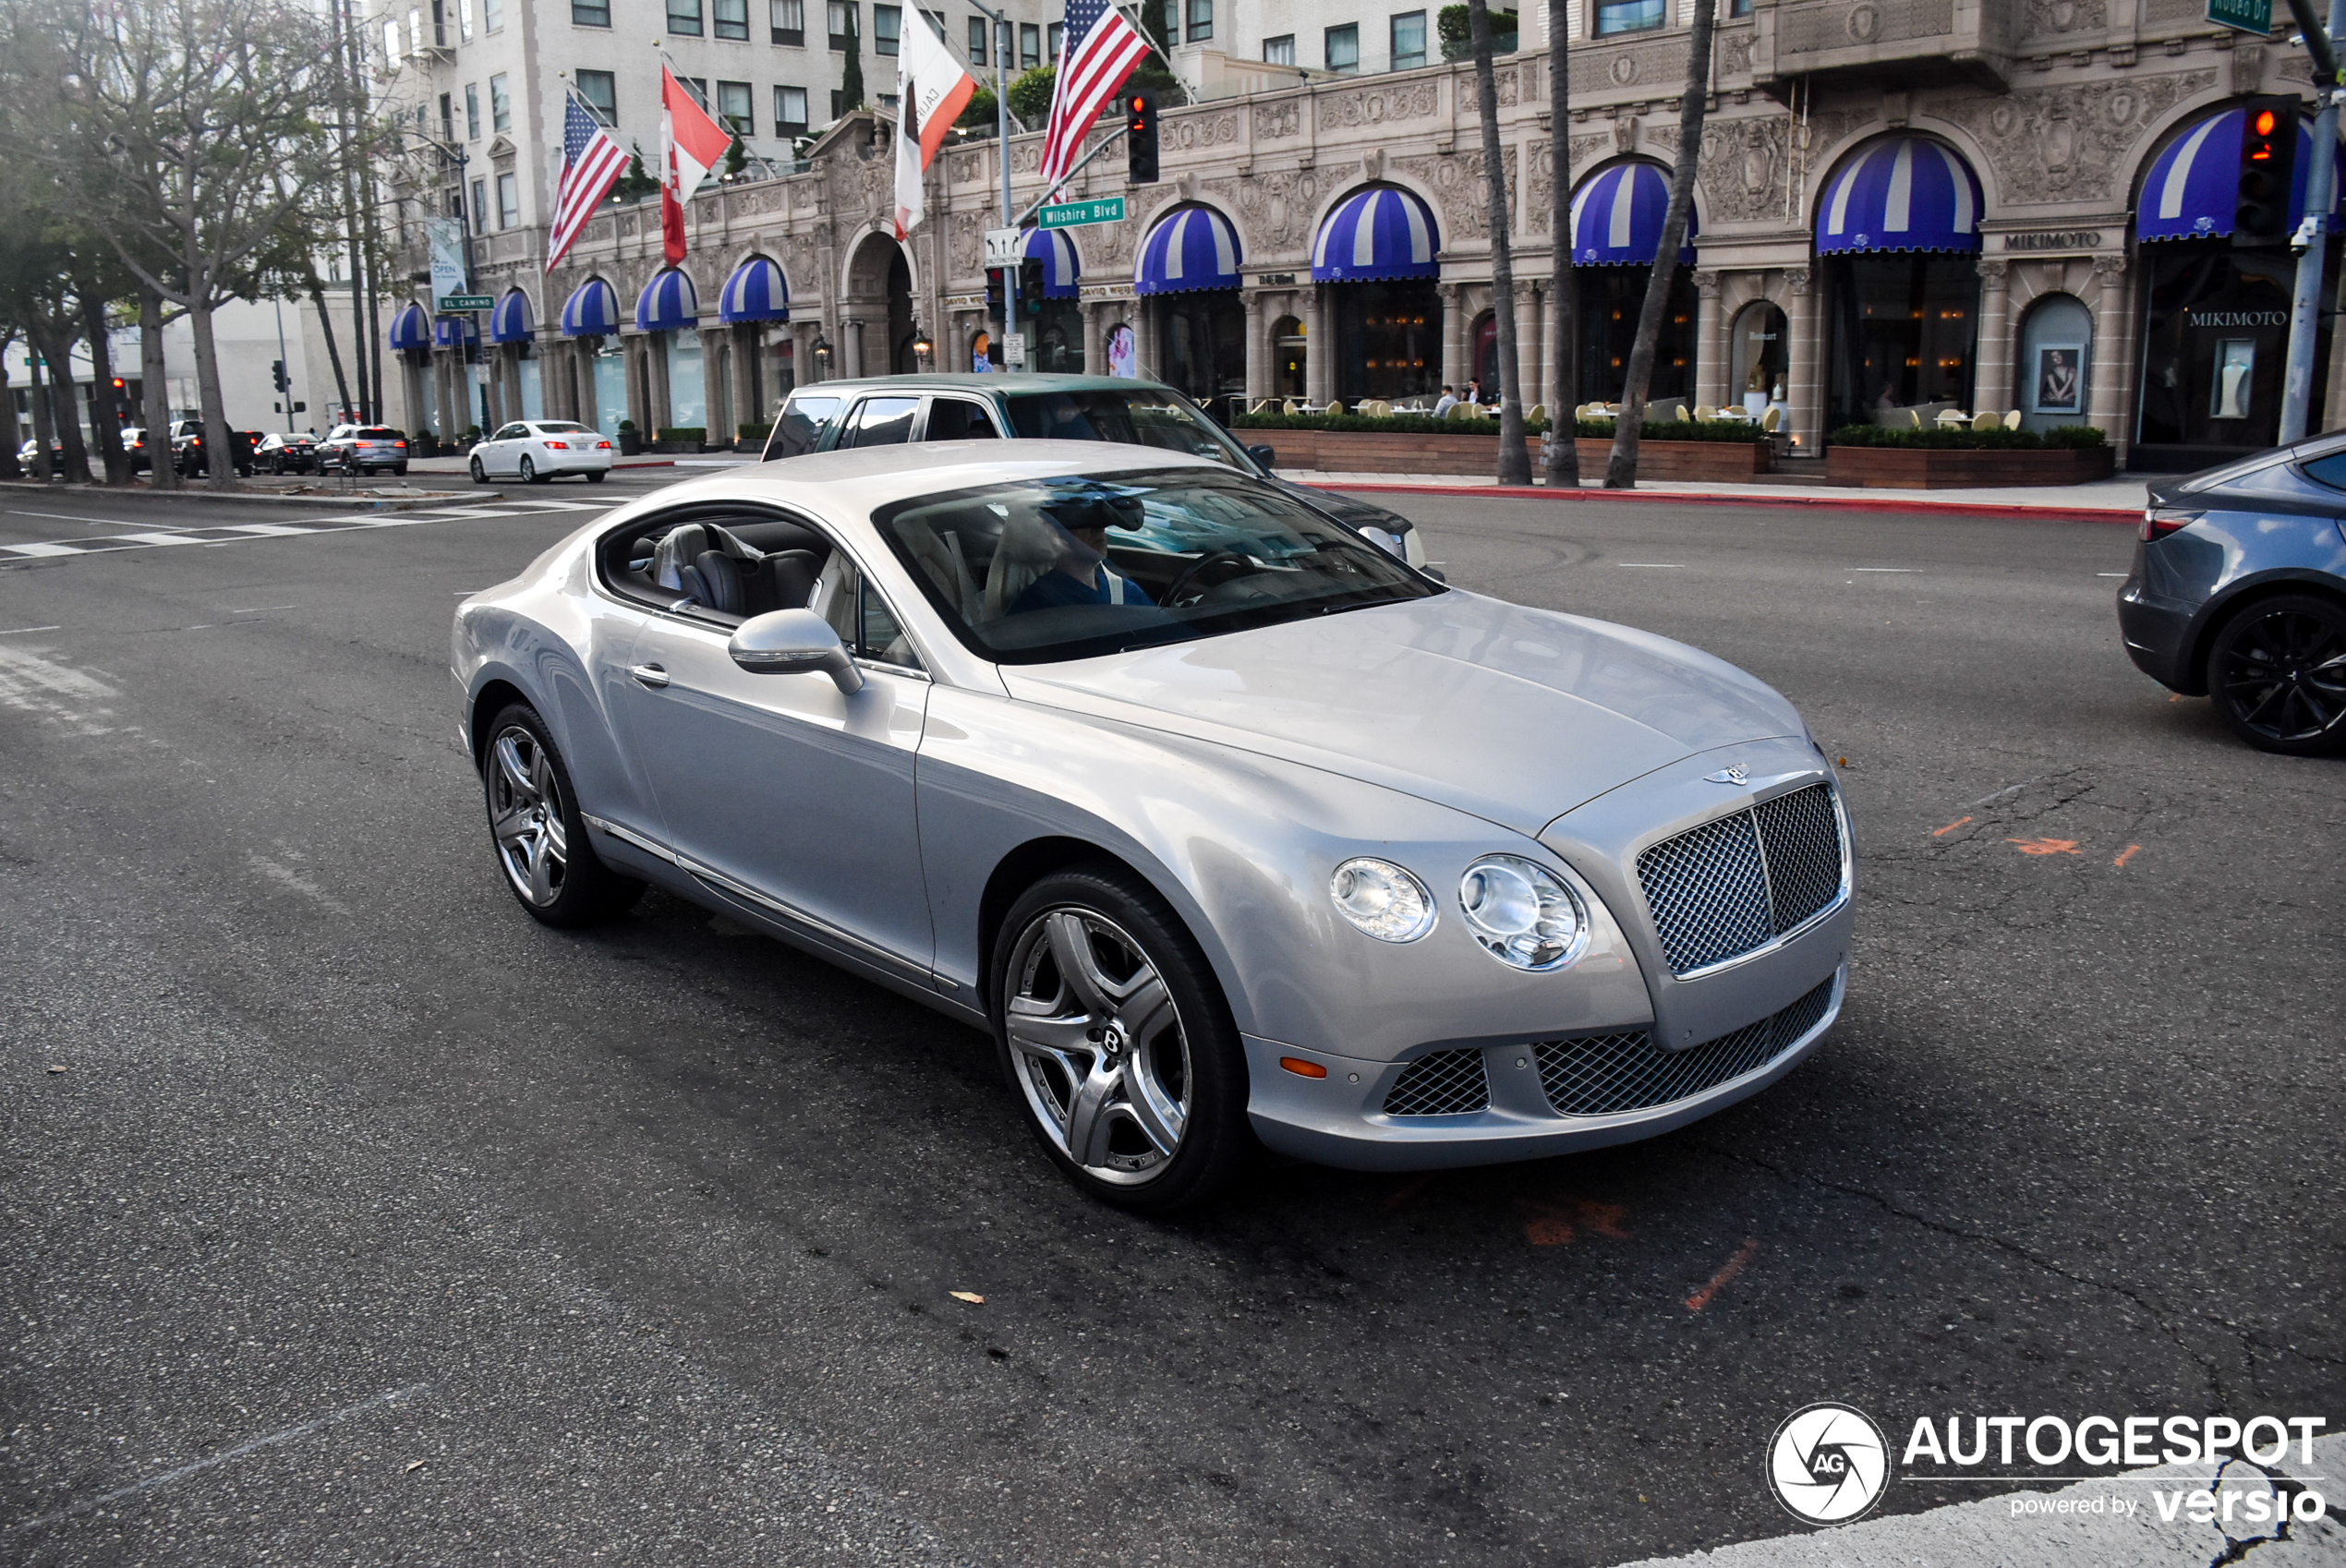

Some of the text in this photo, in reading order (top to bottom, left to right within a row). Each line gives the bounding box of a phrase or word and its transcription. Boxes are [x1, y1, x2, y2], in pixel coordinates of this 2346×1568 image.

[2255, 0, 2267, 21] Dr
[1046, 203, 1117, 223] Wilshire Blvd
[2004, 231, 2101, 250] MIKIMOTO
[433, 265, 456, 273] OPEN
[1079, 287, 1106, 296] DAVID
[943, 297, 967, 306] DAVID
[2190, 311, 2287, 327] MIKIMOTO
